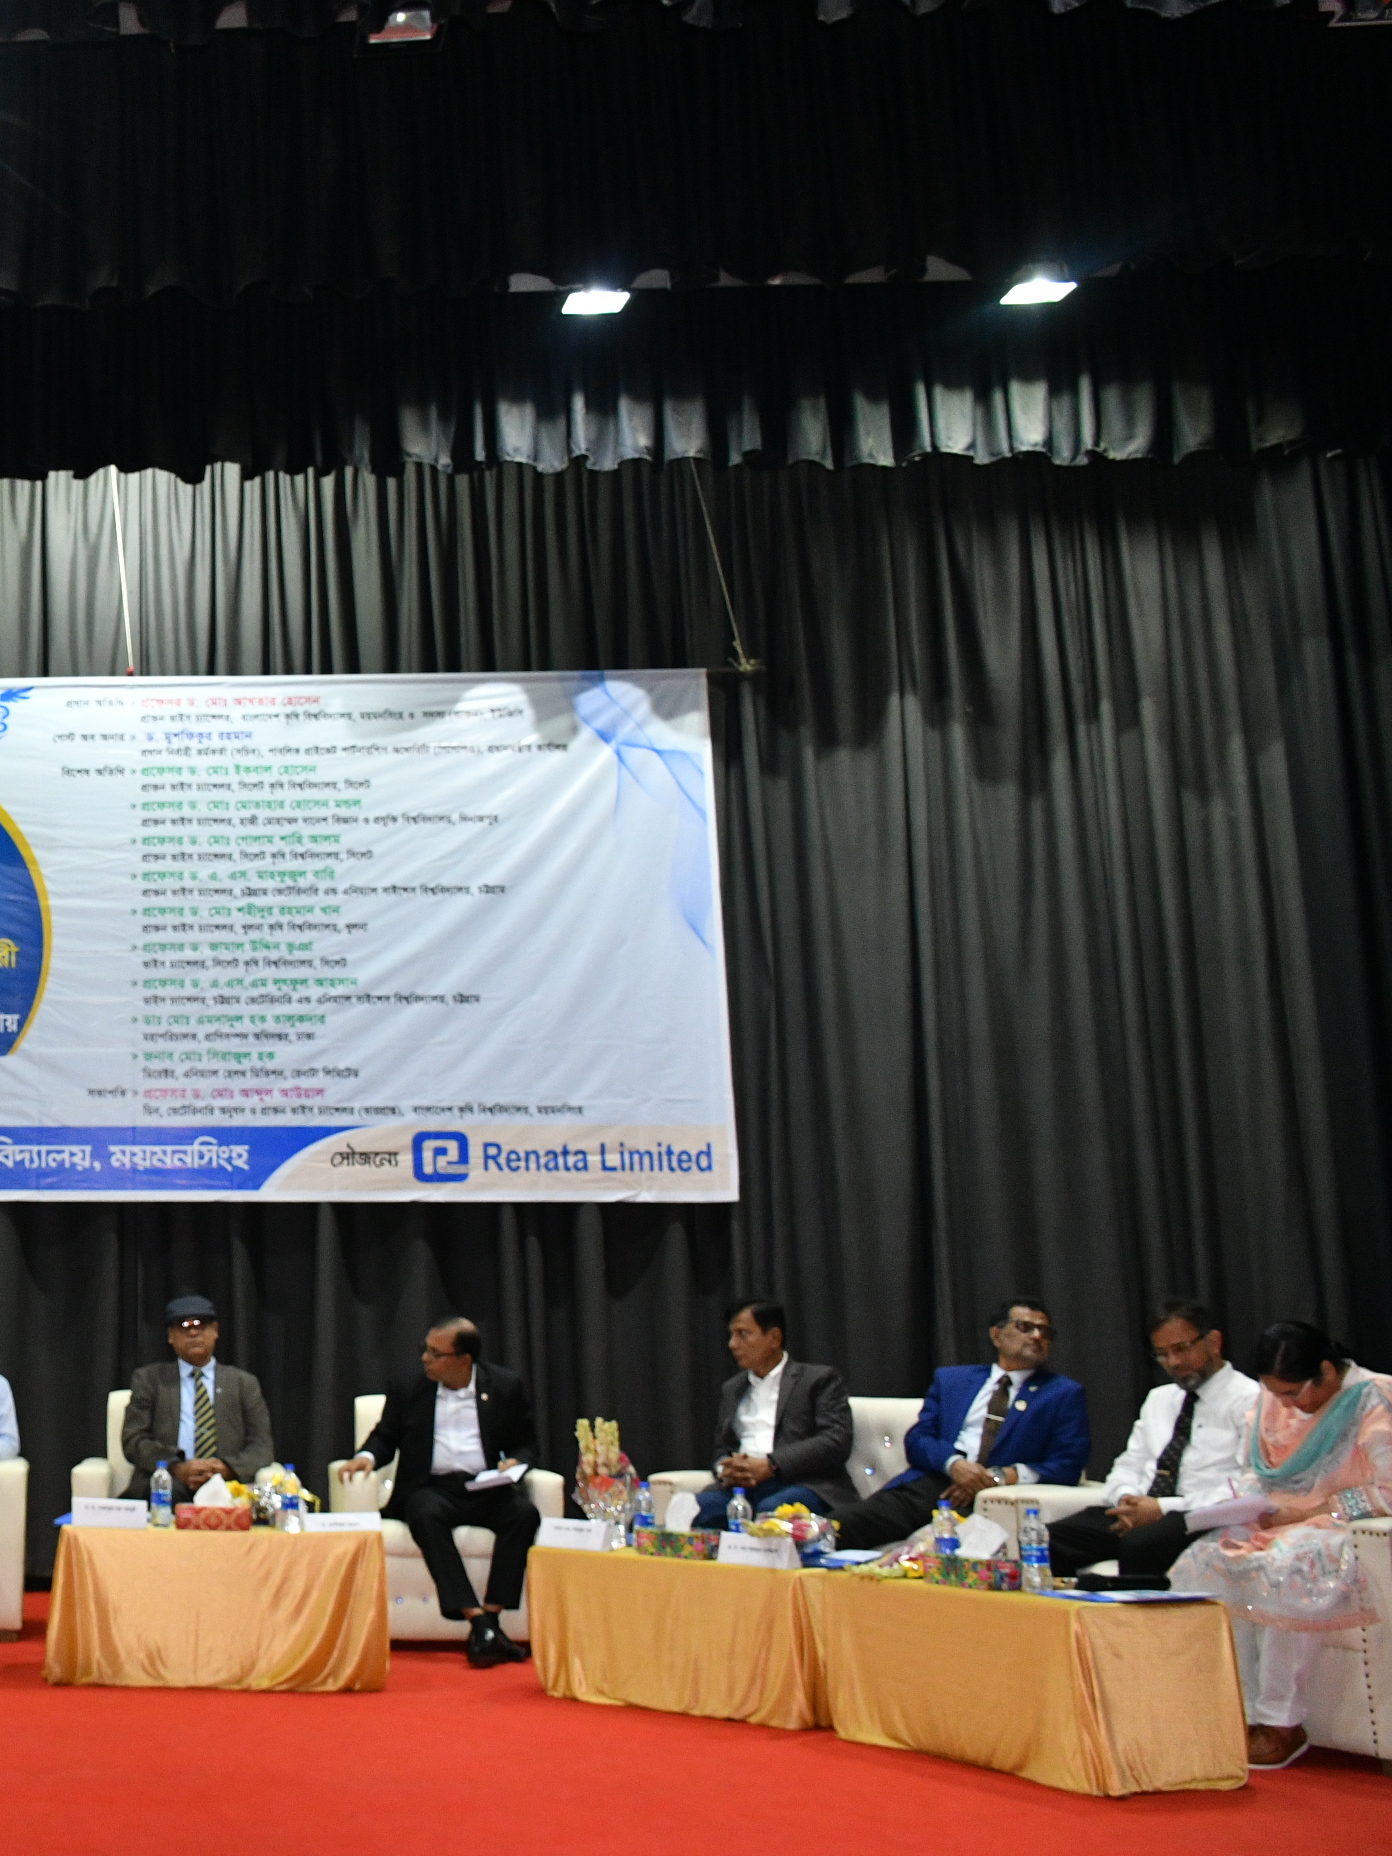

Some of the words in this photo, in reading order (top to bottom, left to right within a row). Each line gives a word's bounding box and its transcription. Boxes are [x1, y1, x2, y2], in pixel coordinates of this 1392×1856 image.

[108, 1136, 250, 1172] ময়মনসিংহ
[330, 1142, 400, 1170] সৌজন্যে
[482, 1142, 590, 1172] Renata
[600, 1142, 714, 1172] Limited
